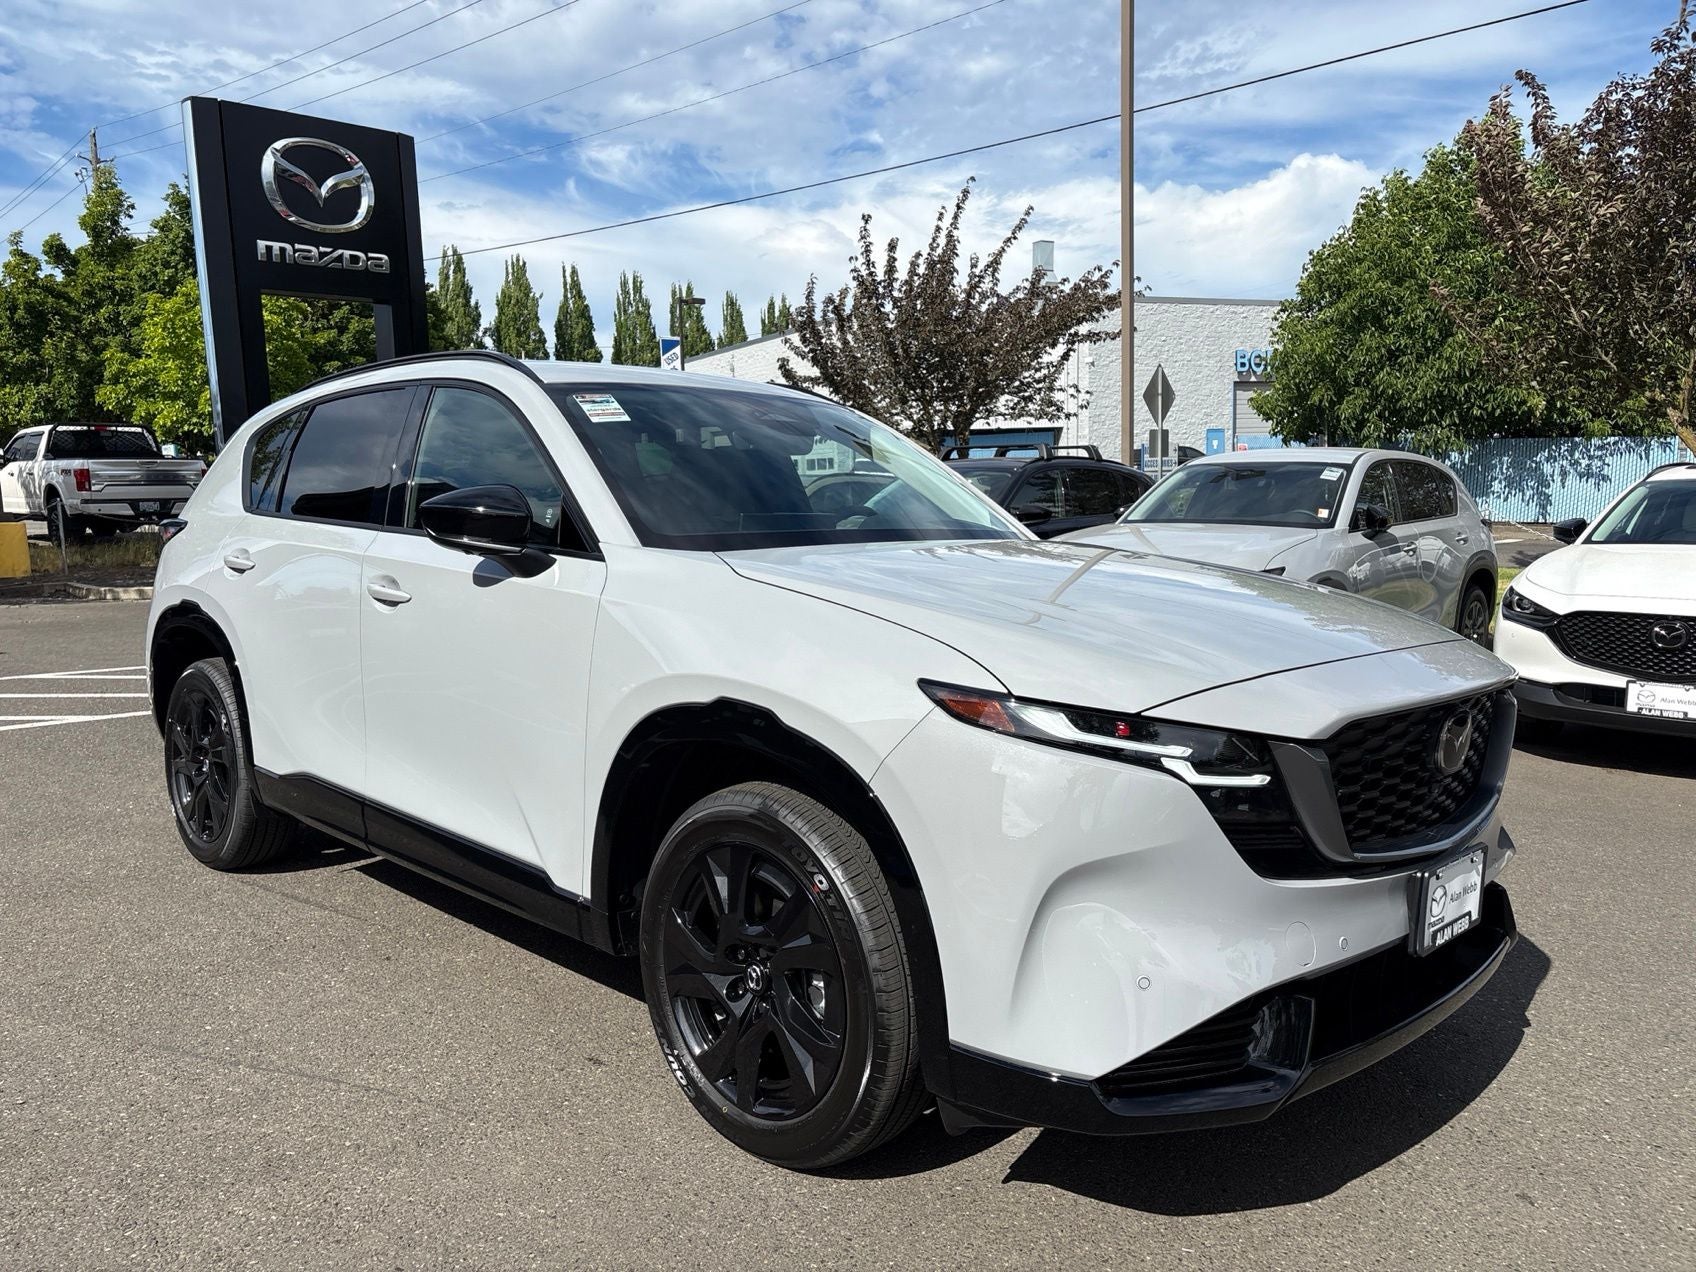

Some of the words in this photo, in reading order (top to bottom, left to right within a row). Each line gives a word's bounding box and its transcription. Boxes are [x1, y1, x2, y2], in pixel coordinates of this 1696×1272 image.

[664, 352, 679, 365] USED
[1640, 708, 1661, 717] ALAN
[1449, 890, 1462, 903] Alan
[1462, 881, 1478, 898] Webb
[1436, 924, 1453, 947] ALAN
[1453, 915, 1470, 937] WEBB
